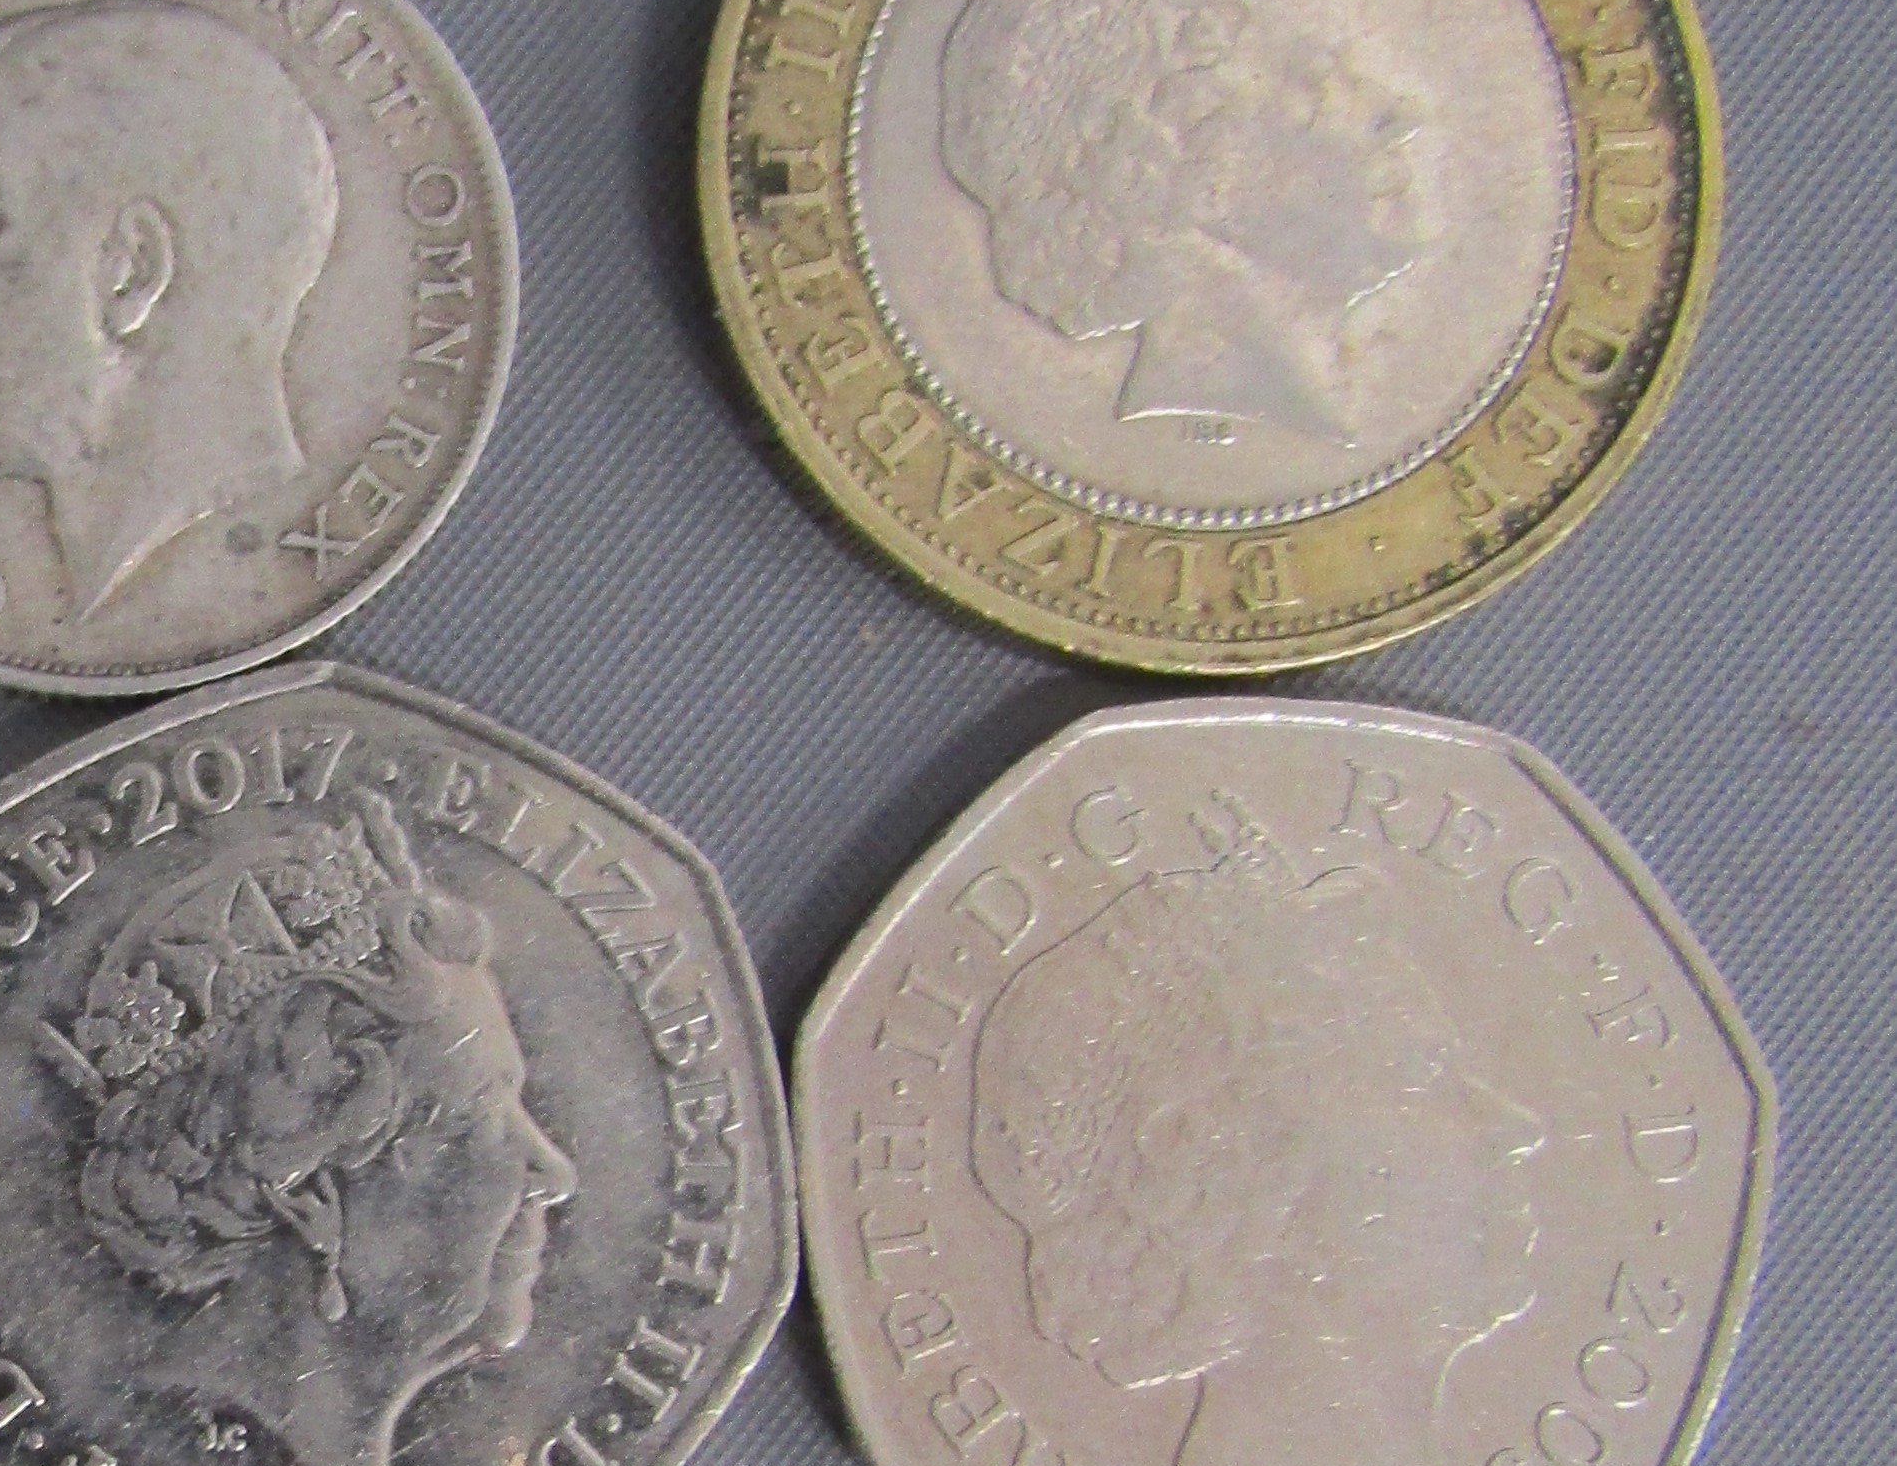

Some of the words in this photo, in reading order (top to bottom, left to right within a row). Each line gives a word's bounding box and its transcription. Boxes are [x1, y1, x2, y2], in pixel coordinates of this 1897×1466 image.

[1583, 45, 1663, 257] FID
[748, 133, 1302, 613] ELIZABETH
[1436, 311, 1628, 533] DEF
[278, 411, 444, 583] REX
[946, 862, 1041, 959] D
[1065, 782, 1153, 868] G
[1328, 756, 1579, 948] REG
[111, 728, 358, 845] 2017
[422, 750, 749, 1306] ELIZABETH
[609, 1314, 702, 1429] II
[870, 961, 977, 1074] II
[1586, 981, 1680, 1053] F
[1619, 1109, 1700, 1186] D
